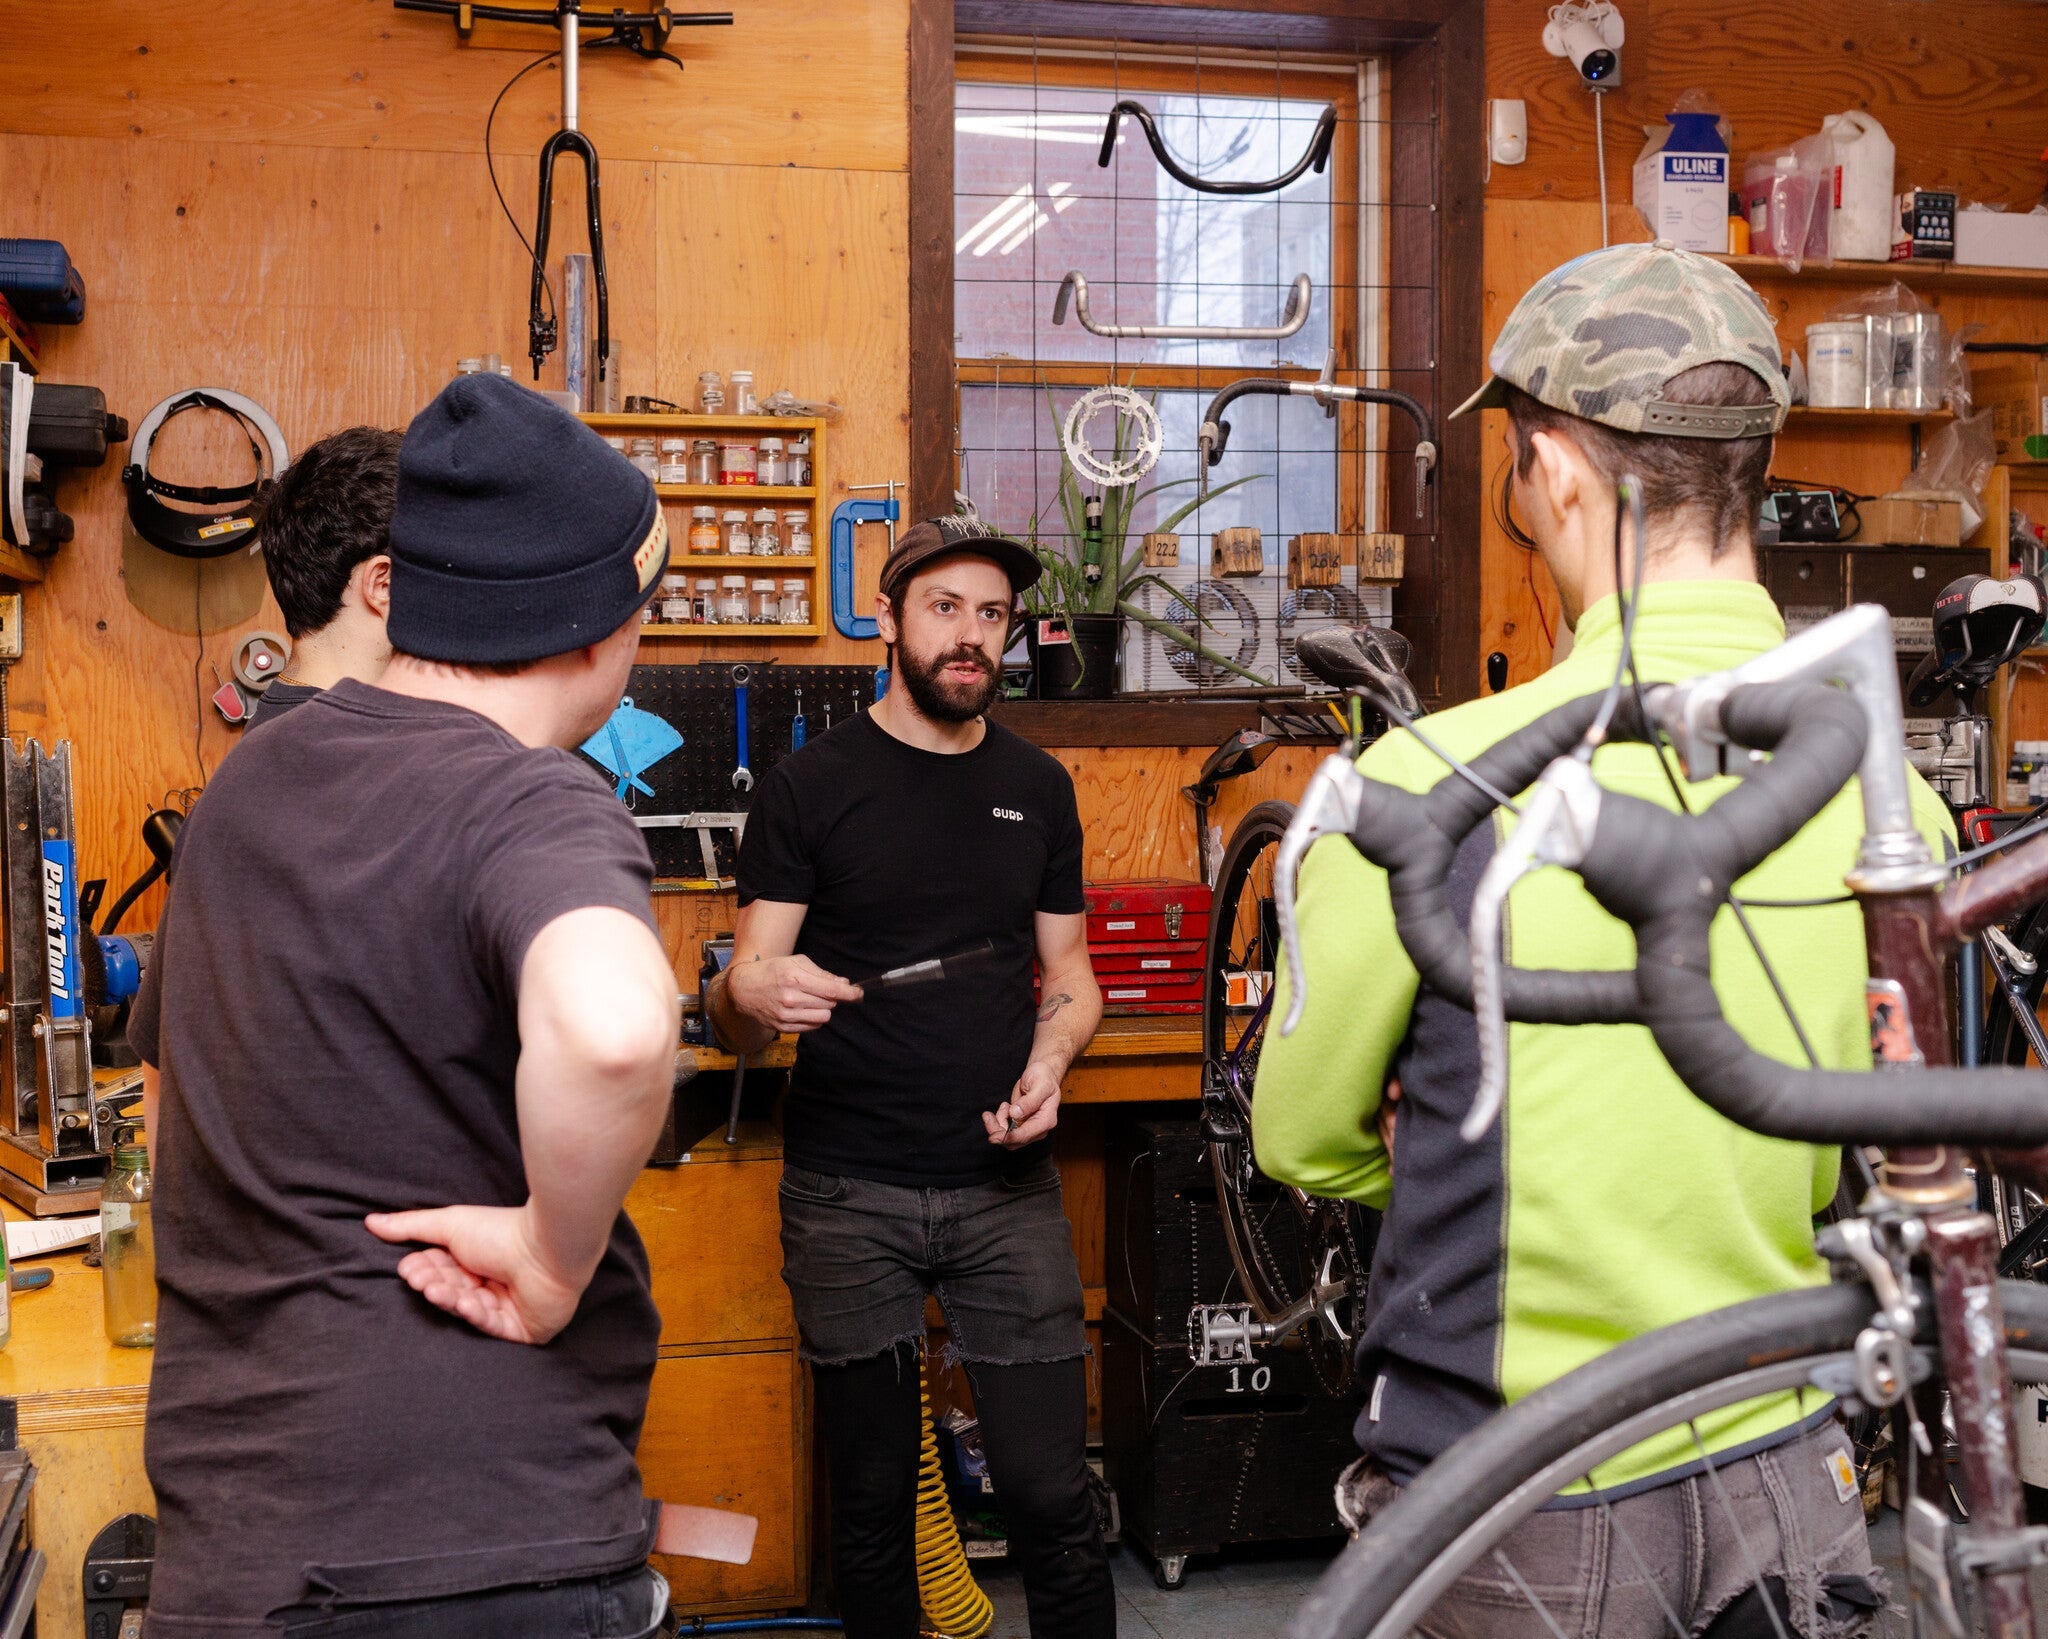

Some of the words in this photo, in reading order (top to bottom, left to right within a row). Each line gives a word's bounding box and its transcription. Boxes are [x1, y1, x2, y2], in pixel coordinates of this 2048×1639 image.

[1672, 158, 1718, 174] ULINE
[1156, 542, 1177, 557] 22.2
[1936, 592, 1963, 609] WTB
[992, 807, 1024, 822] GURP
[1225, 1366, 1271, 1392] 10
